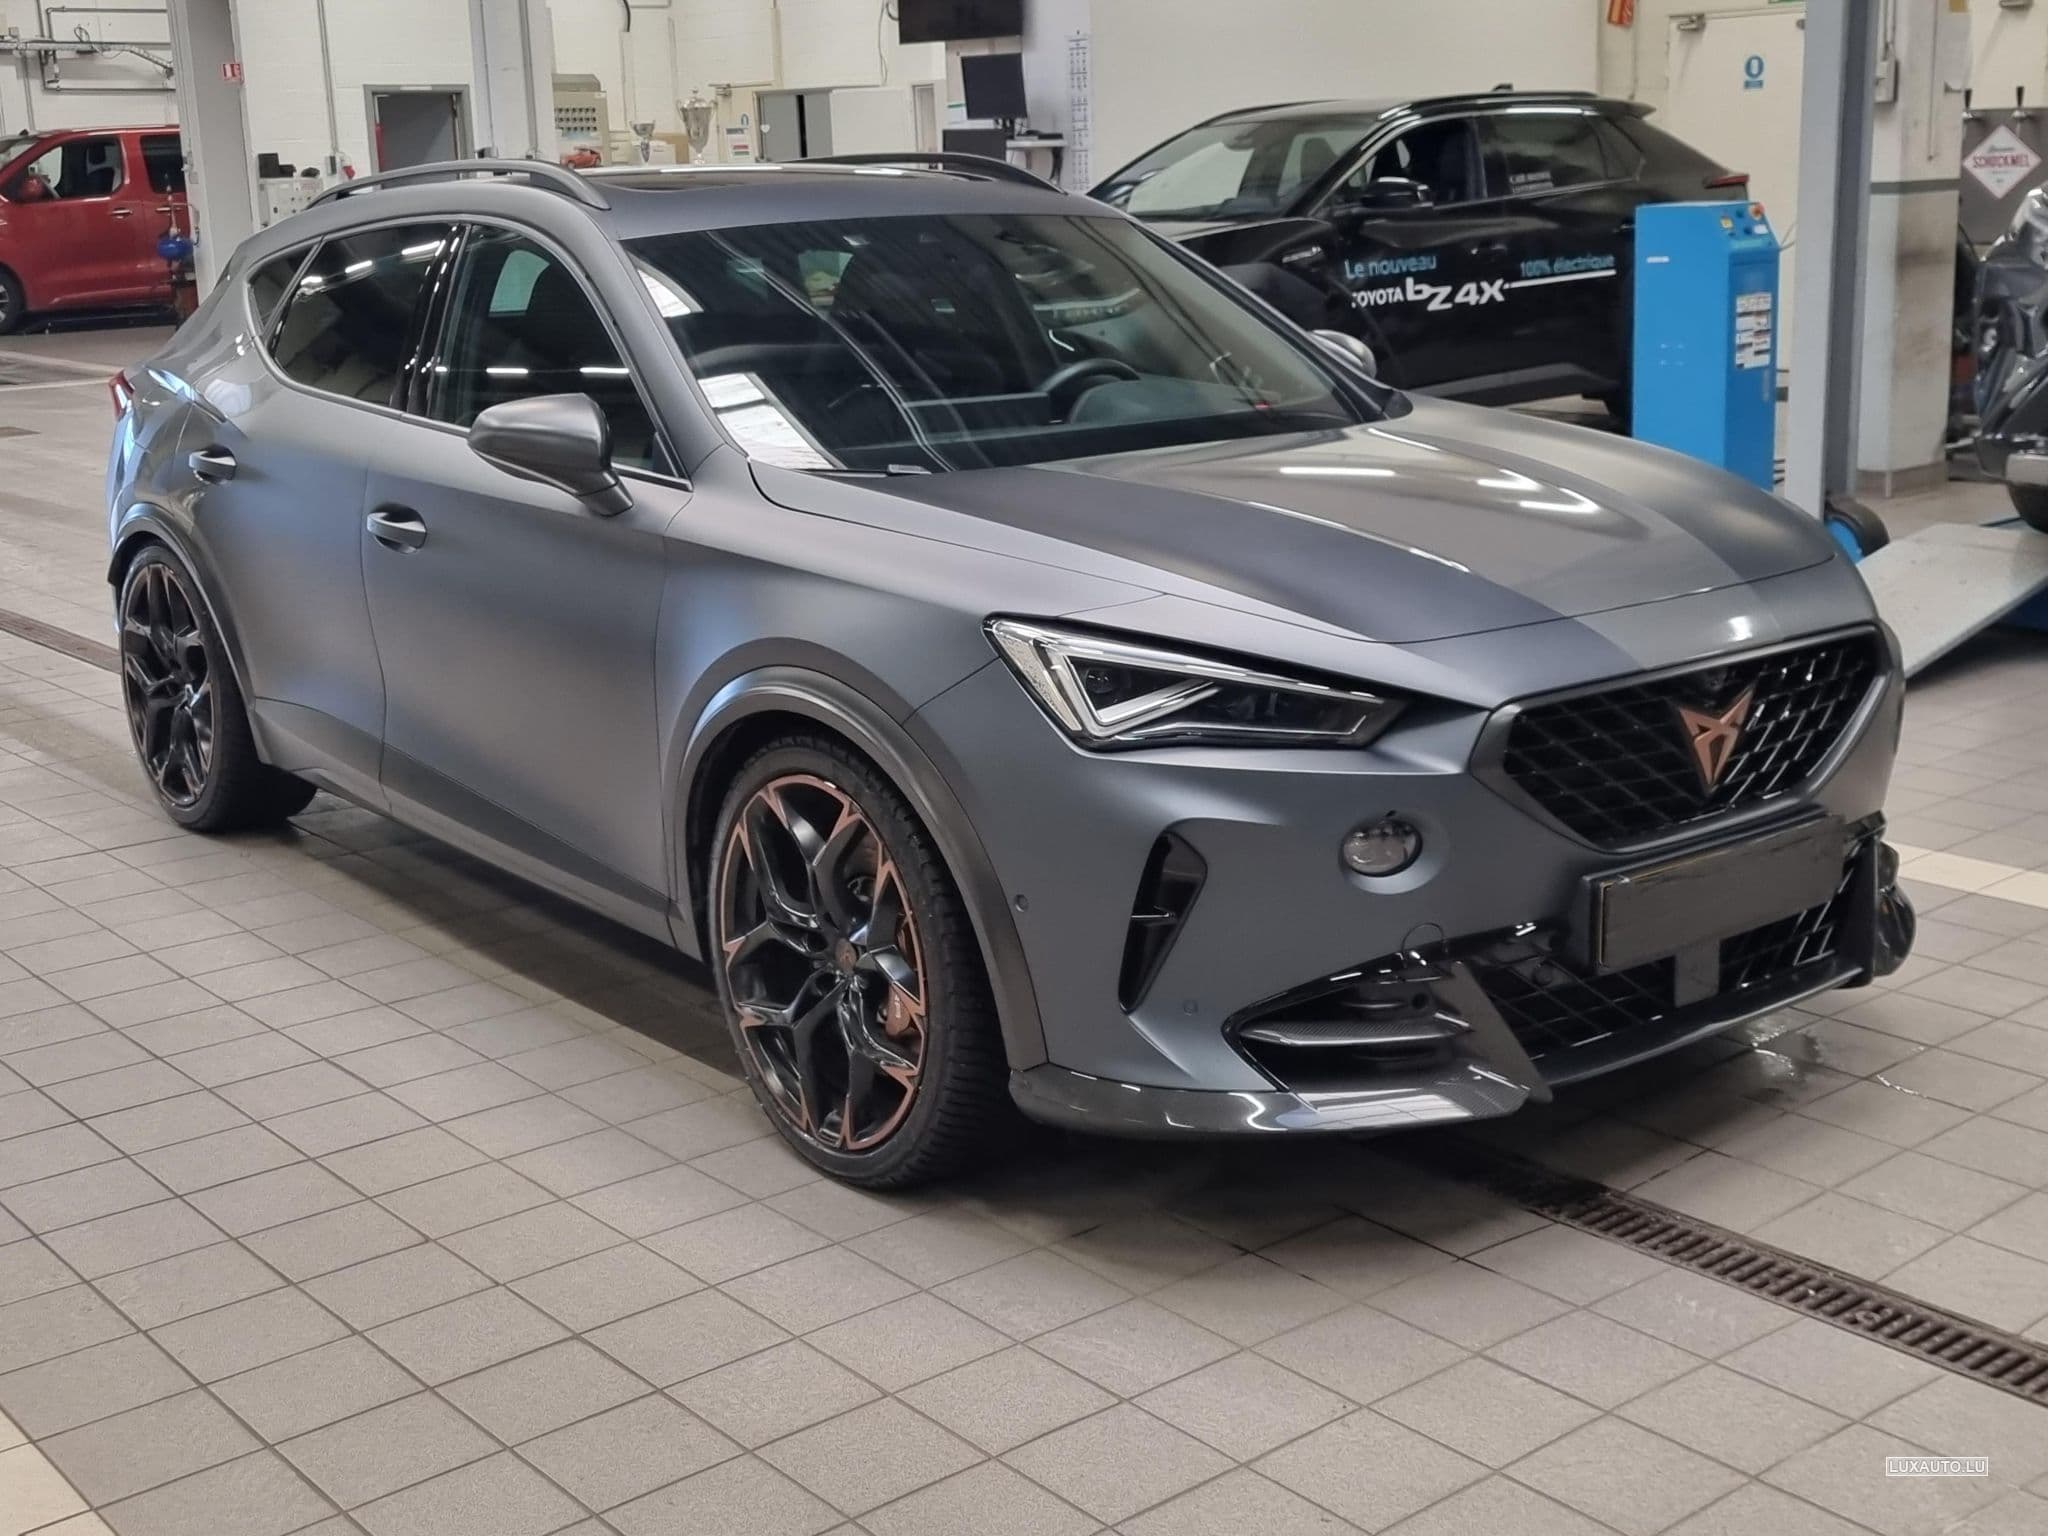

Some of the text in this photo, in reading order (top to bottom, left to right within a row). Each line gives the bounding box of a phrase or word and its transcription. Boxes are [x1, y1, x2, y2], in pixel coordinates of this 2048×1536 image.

[1345, 256, 1437, 279] Le nouveau
[1520, 259, 1551, 277] 100%
